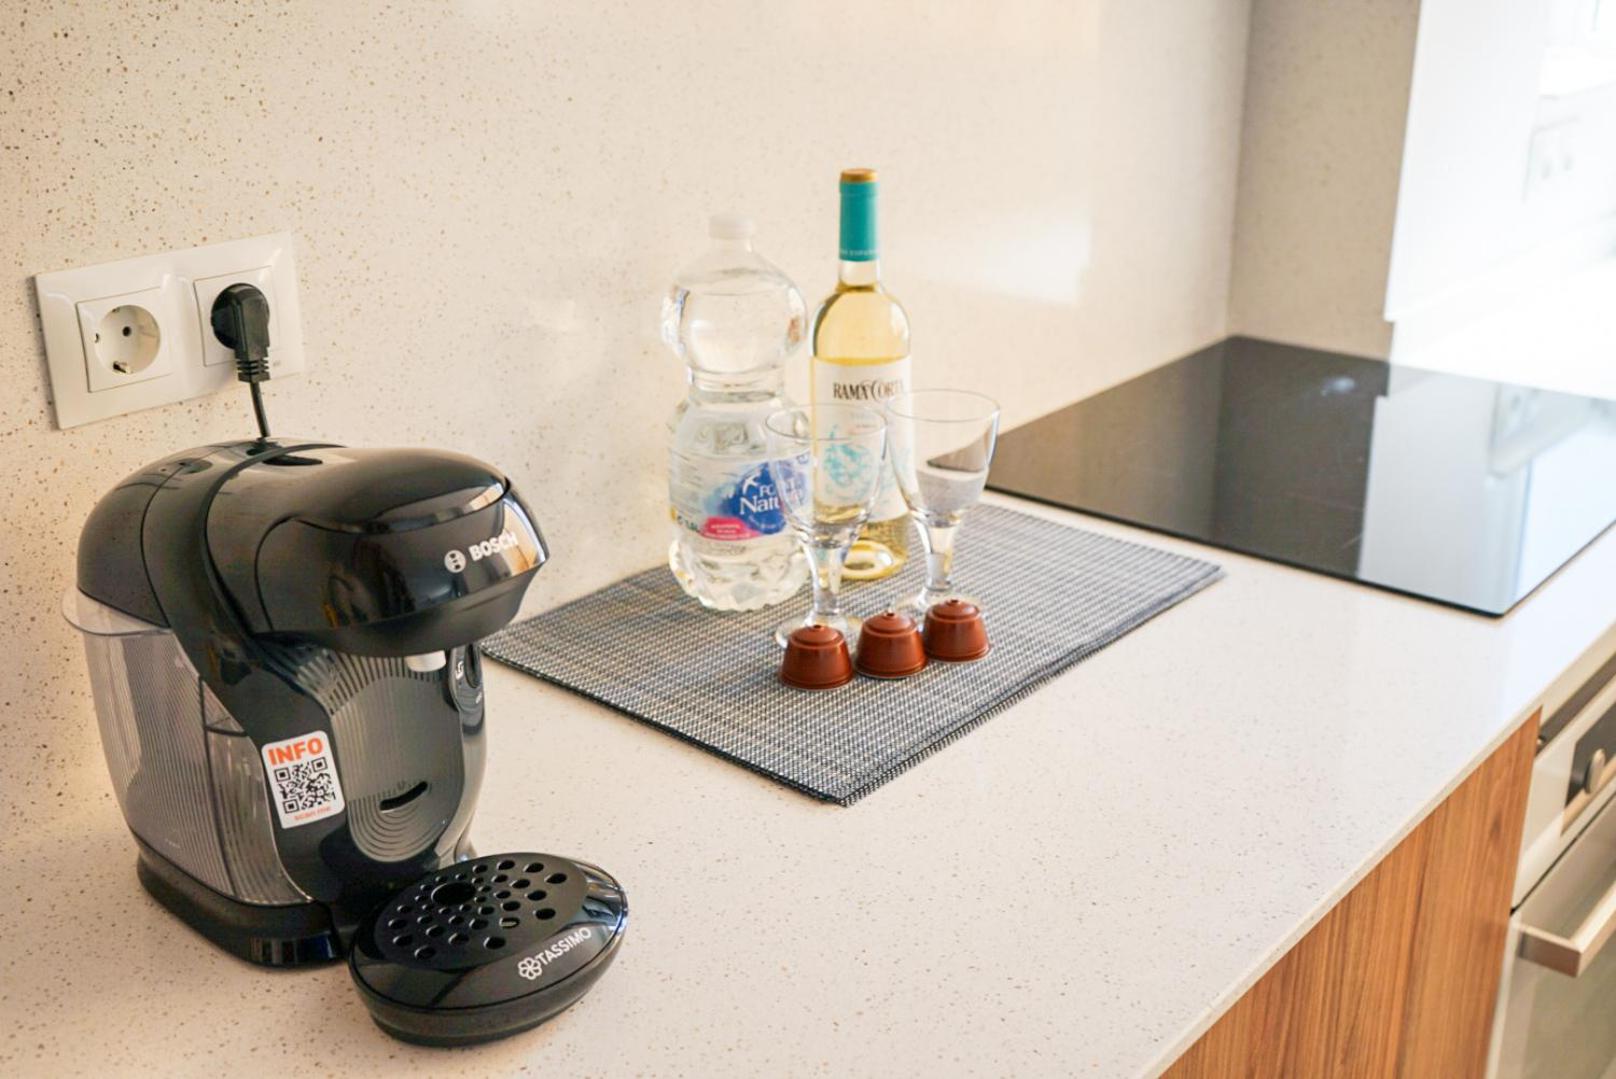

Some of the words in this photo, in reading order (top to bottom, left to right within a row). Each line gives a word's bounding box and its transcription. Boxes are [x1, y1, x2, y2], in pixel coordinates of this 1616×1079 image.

[468, 530, 518, 562] BOSCH
[267, 737, 323, 766] INFO
[535, 927, 592, 966] TASSIMO
